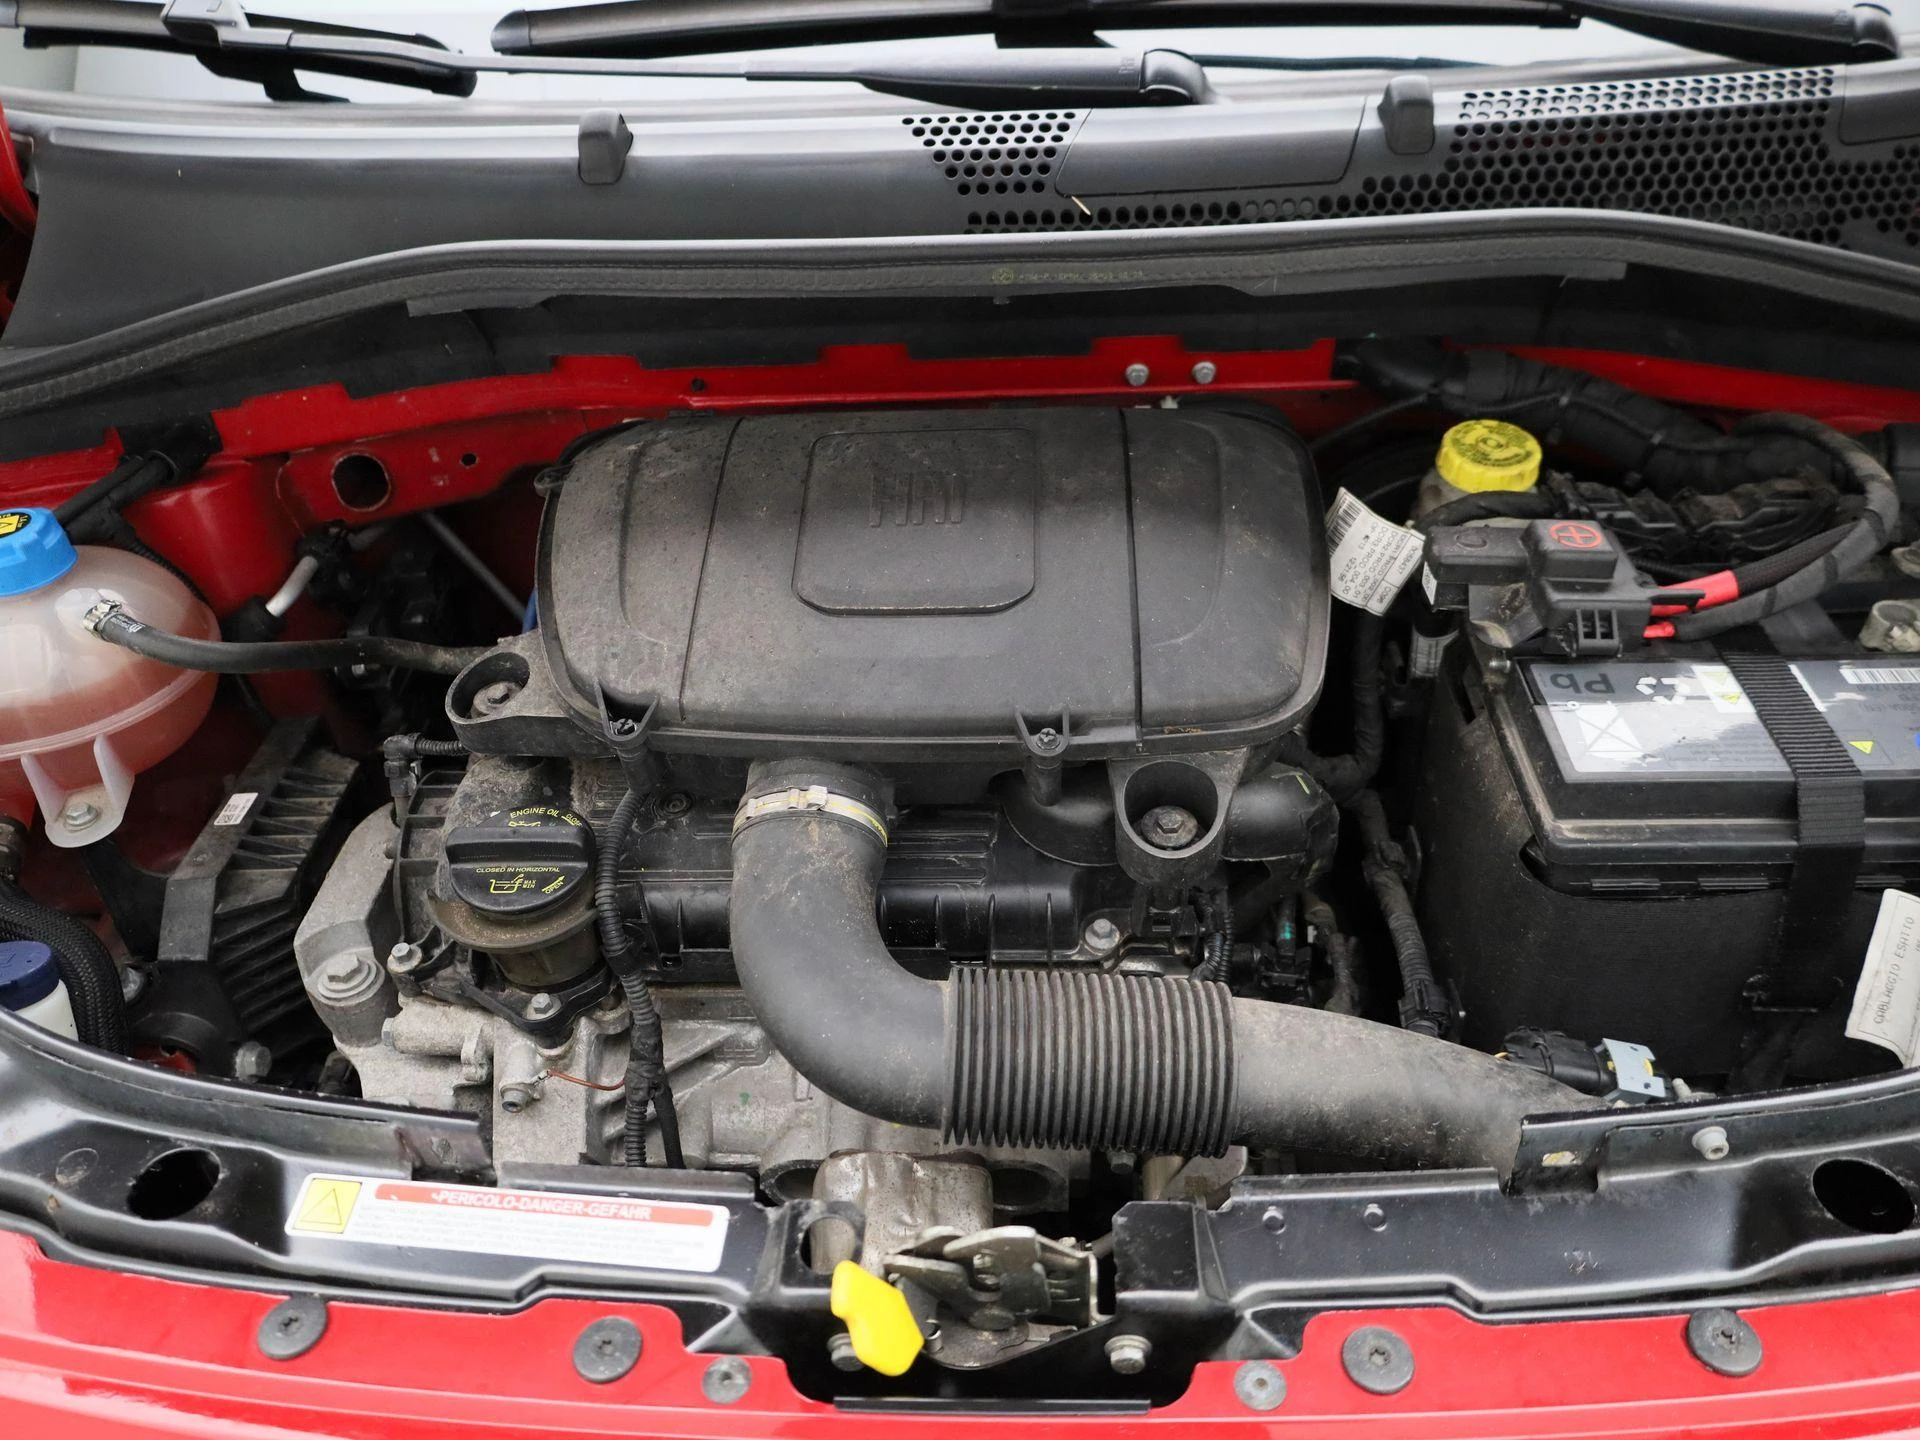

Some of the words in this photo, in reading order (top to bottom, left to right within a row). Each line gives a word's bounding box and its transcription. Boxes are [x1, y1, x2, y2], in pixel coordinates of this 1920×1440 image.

[1550, 673, 1615, 694] Pb
[509, 807, 546, 820] ENGINE
[546, 808, 561, 818] OIL
[476, 866, 506, 874] CLOSED
[515, 866, 560, 874] HORIZONTAL
[544, 880, 564, 895] OPEN
[1894, 916, 1916, 959] ESATTO
